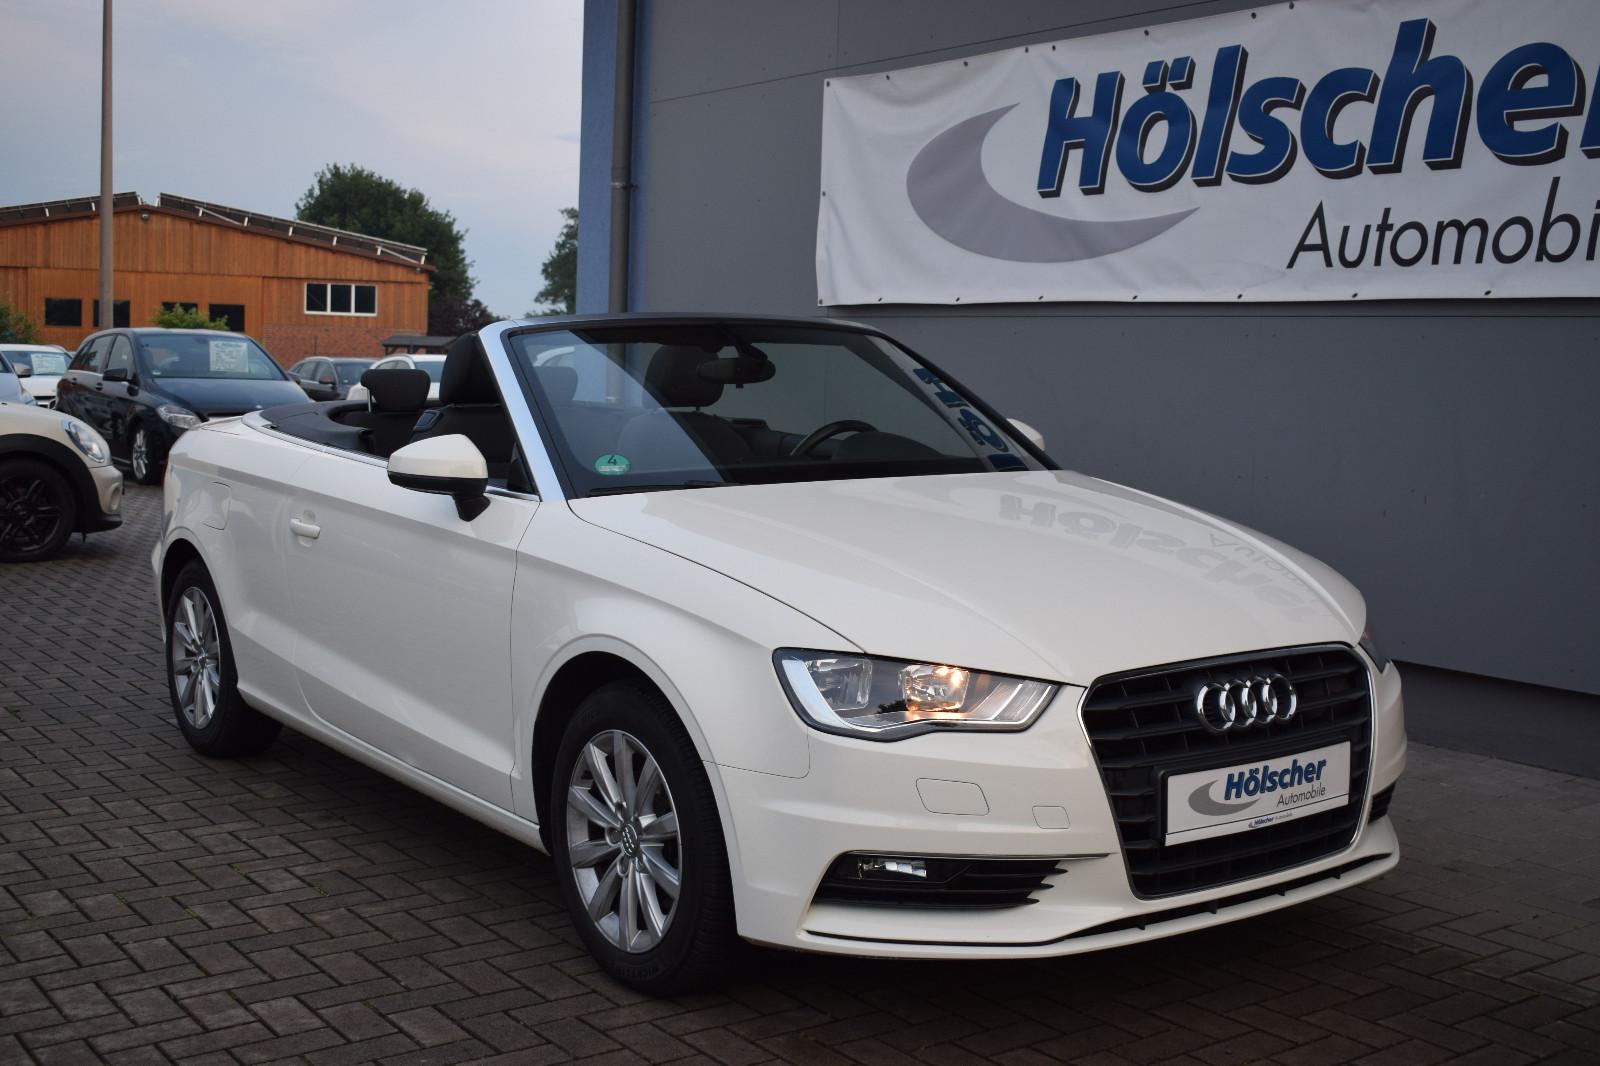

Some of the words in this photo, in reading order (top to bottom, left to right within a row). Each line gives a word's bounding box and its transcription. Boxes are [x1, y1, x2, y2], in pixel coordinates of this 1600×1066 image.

[607, 455, 618, 466] 4
[1224, 759, 1326, 800] Hölscher
[1276, 784, 1326, 807] Automobile
